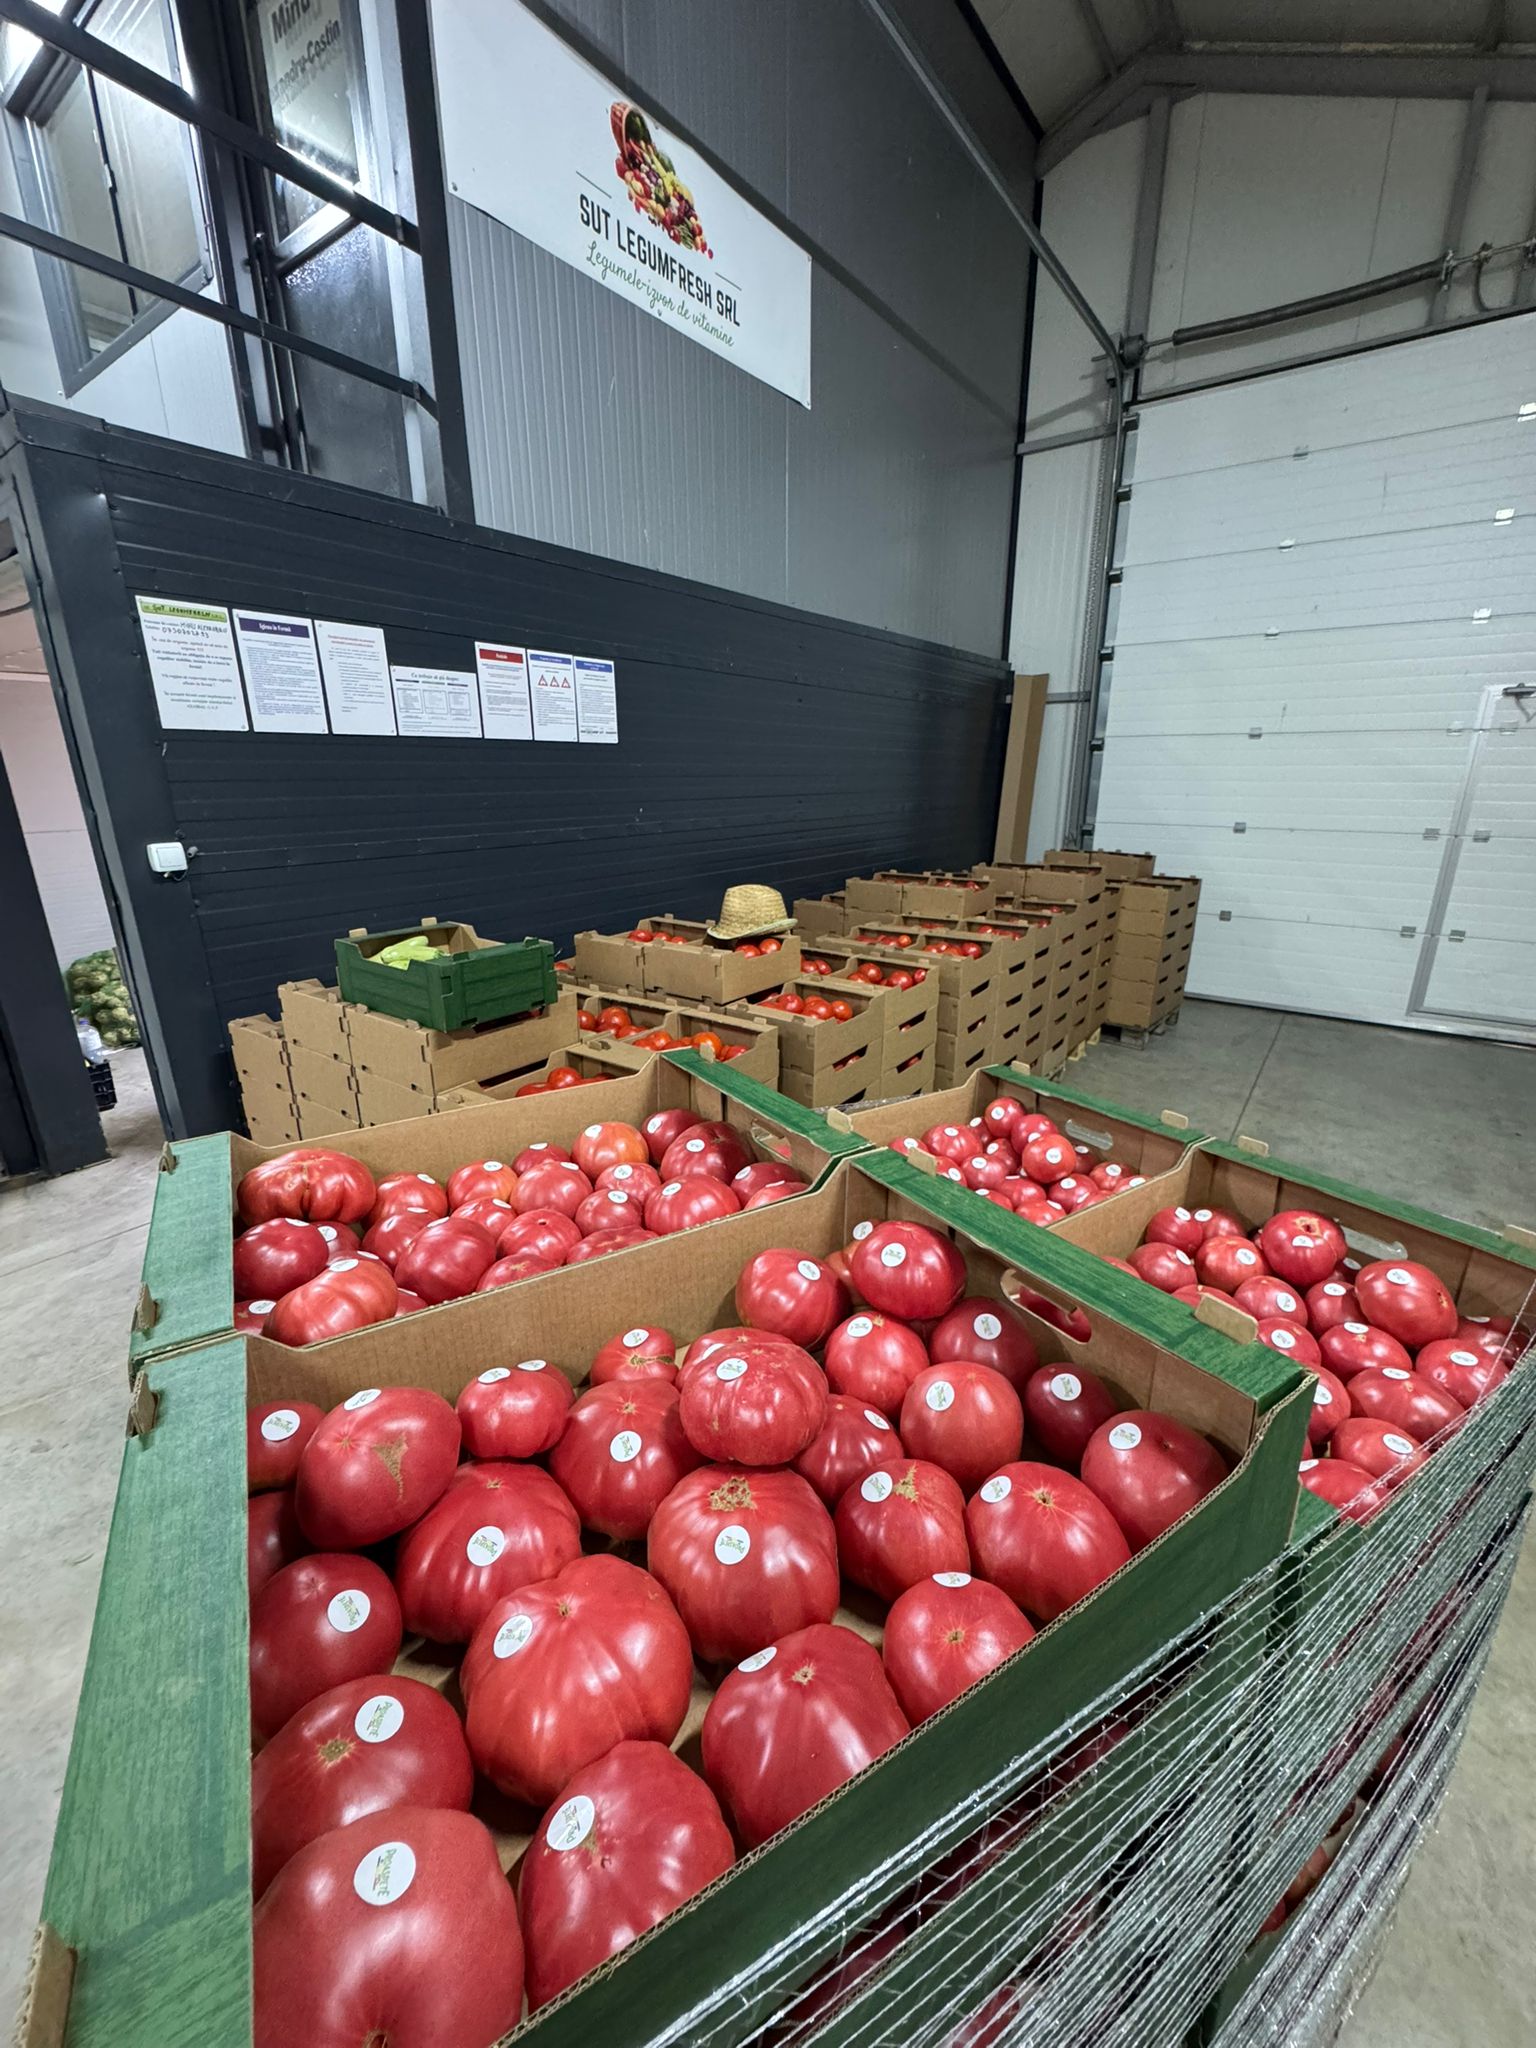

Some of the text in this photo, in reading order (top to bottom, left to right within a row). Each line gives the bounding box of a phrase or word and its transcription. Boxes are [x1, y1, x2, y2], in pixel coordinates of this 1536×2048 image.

[579, 193, 741, 327] SUT LEGUMFRESH SRL
[677, 301, 691, 320] de
[692, 312, 735, 347] vitamine
